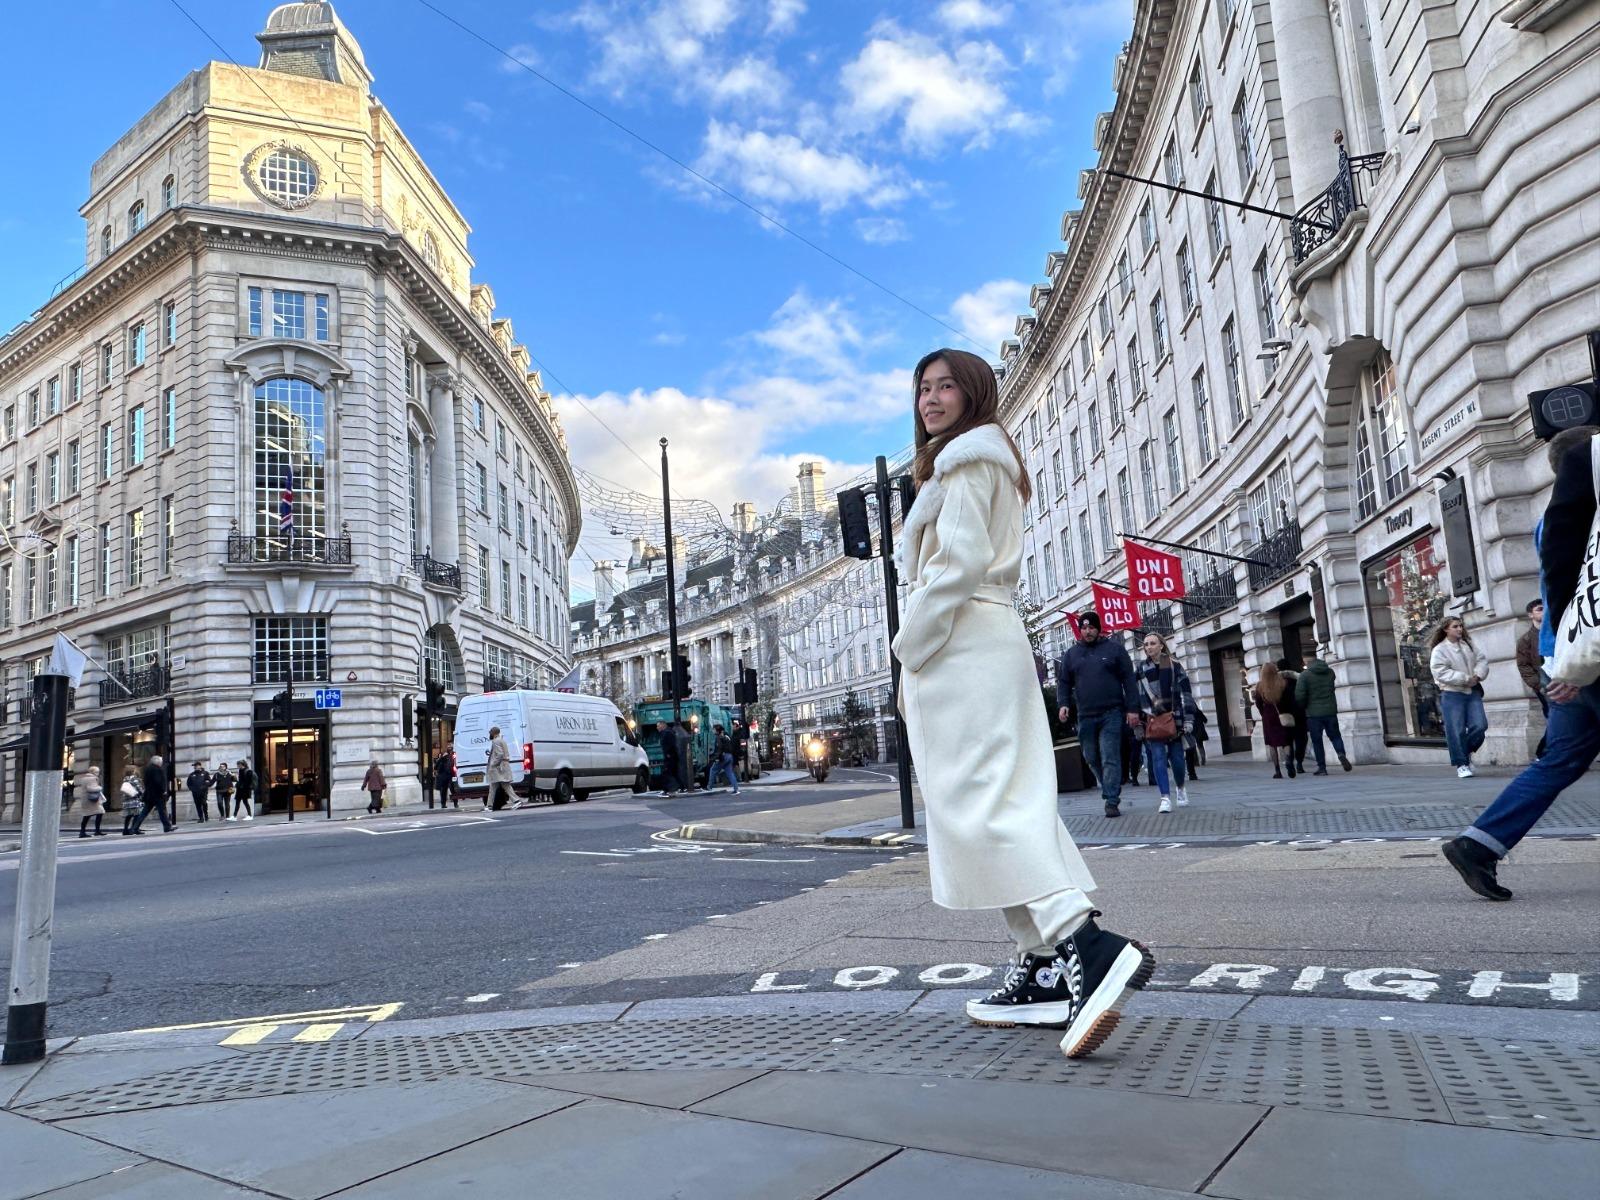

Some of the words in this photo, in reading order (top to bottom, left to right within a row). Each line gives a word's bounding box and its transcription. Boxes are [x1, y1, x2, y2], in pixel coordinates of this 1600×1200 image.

[1421, 427, 1441, 450] REGENT
[1443, 409, 1464, 432] STREET
[1384, 506, 1412, 534] Theory
[1135, 558, 1169, 575] UNI
[1138, 577, 1175, 596] QLO
[1102, 597, 1127, 610] UNI
[1104, 611, 1133, 627] QLO
[555, 715, 581, 730] LARSON
[751, 963, 993, 992] LOO
[1190, 962, 1580, 1000] RIGH
